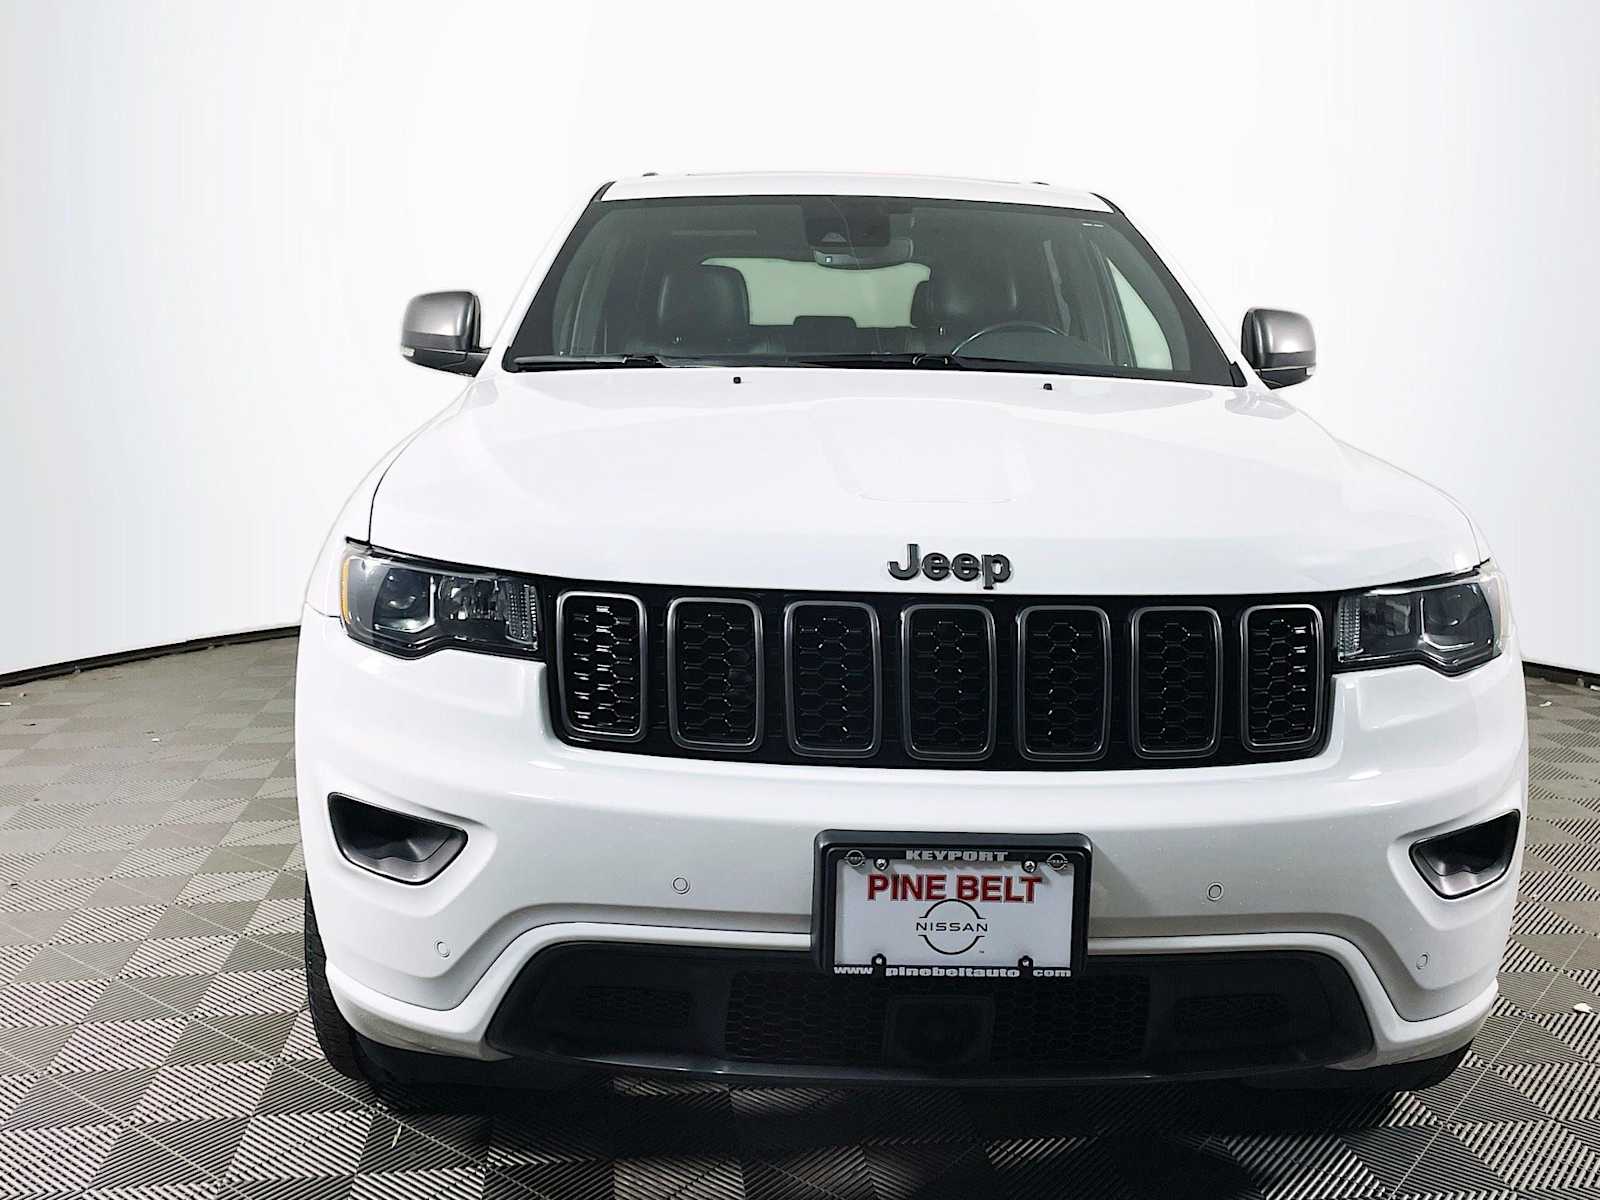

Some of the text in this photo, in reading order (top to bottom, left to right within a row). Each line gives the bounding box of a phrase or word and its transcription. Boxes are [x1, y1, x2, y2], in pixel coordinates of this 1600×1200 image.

[887, 543, 1011, 590] Jeep
[905, 850, 1009, 861] KEYPORT
[867, 874, 1042, 903] PINE BELT
[915, 922, 988, 932] NISSAN
